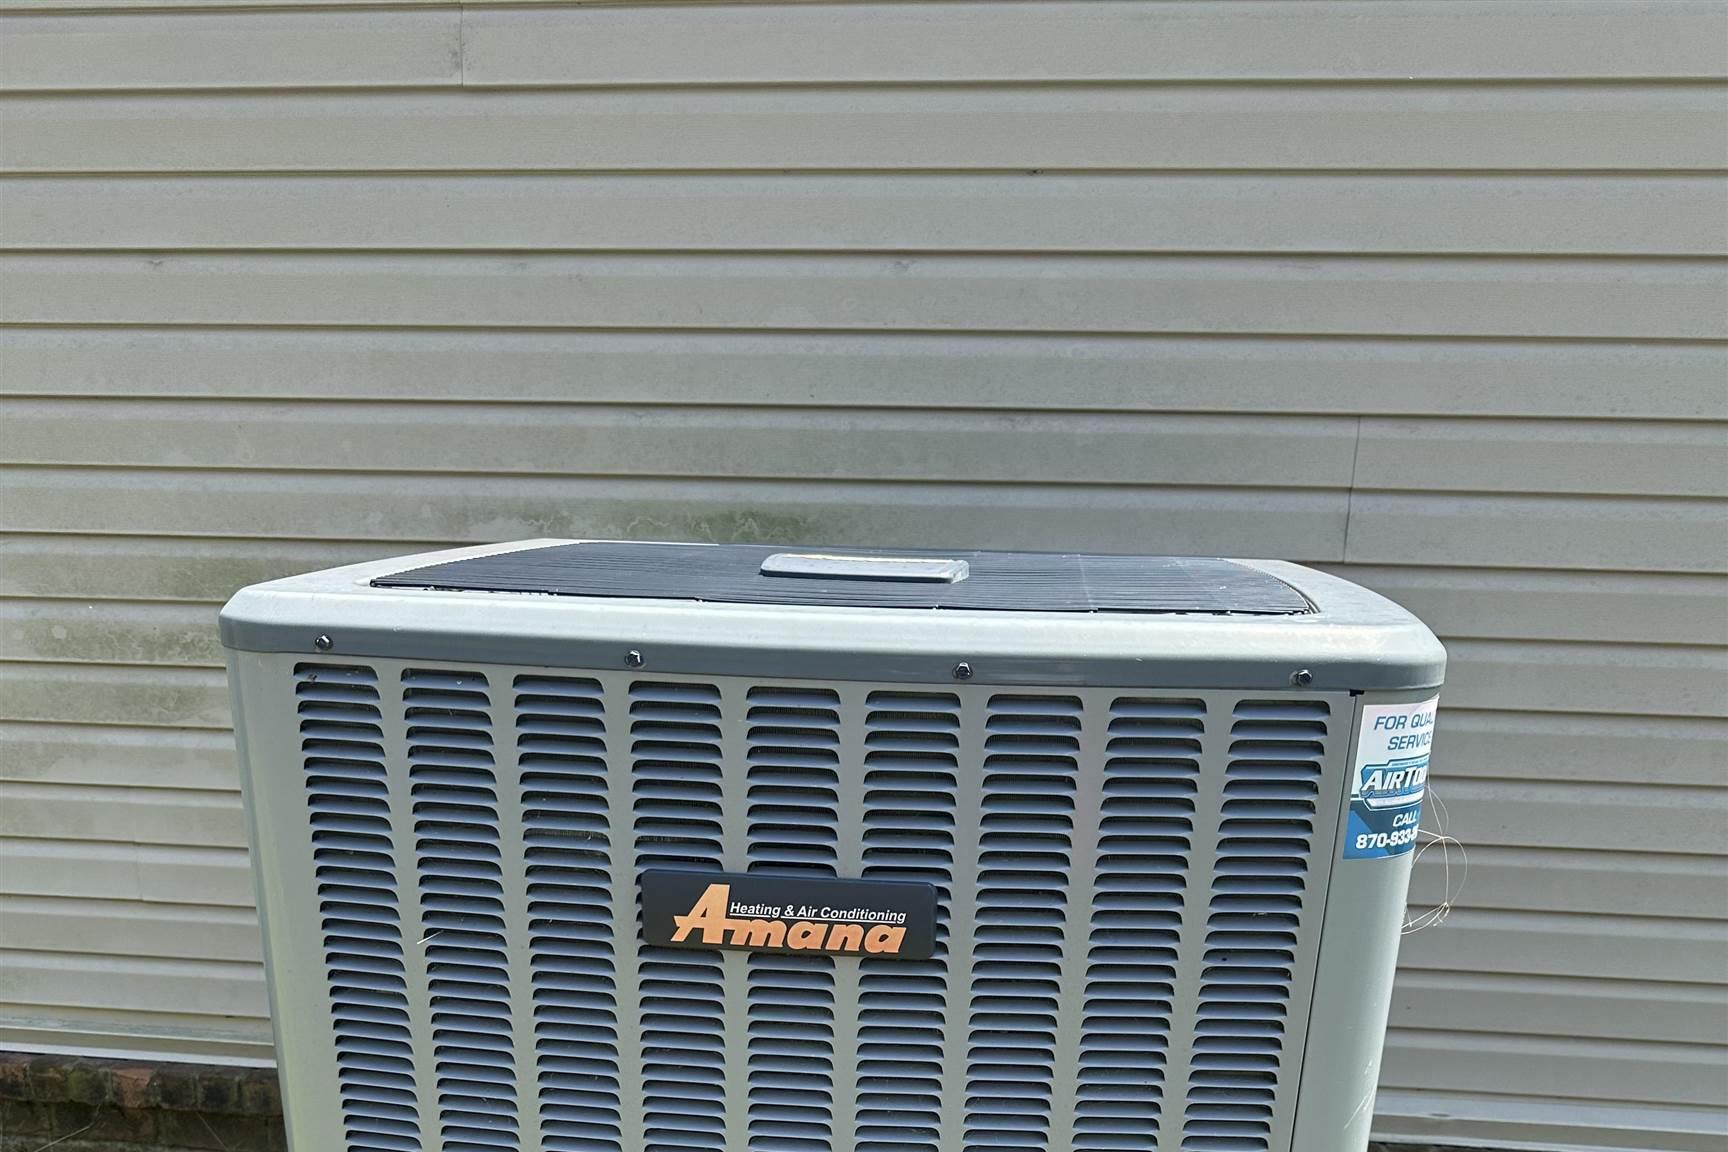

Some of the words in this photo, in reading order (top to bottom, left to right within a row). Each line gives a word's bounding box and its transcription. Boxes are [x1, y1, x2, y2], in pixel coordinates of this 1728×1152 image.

[1374, 715, 1407, 731] FOR
[1393, 811, 1417, 827] CALL
[671, 883, 907, 953] Amana
[730, 902, 781, 918] Heating
[784, 904, 794, 916] &
[797, 905, 817, 918] Air
[821, 907, 907, 923] Conditioning
